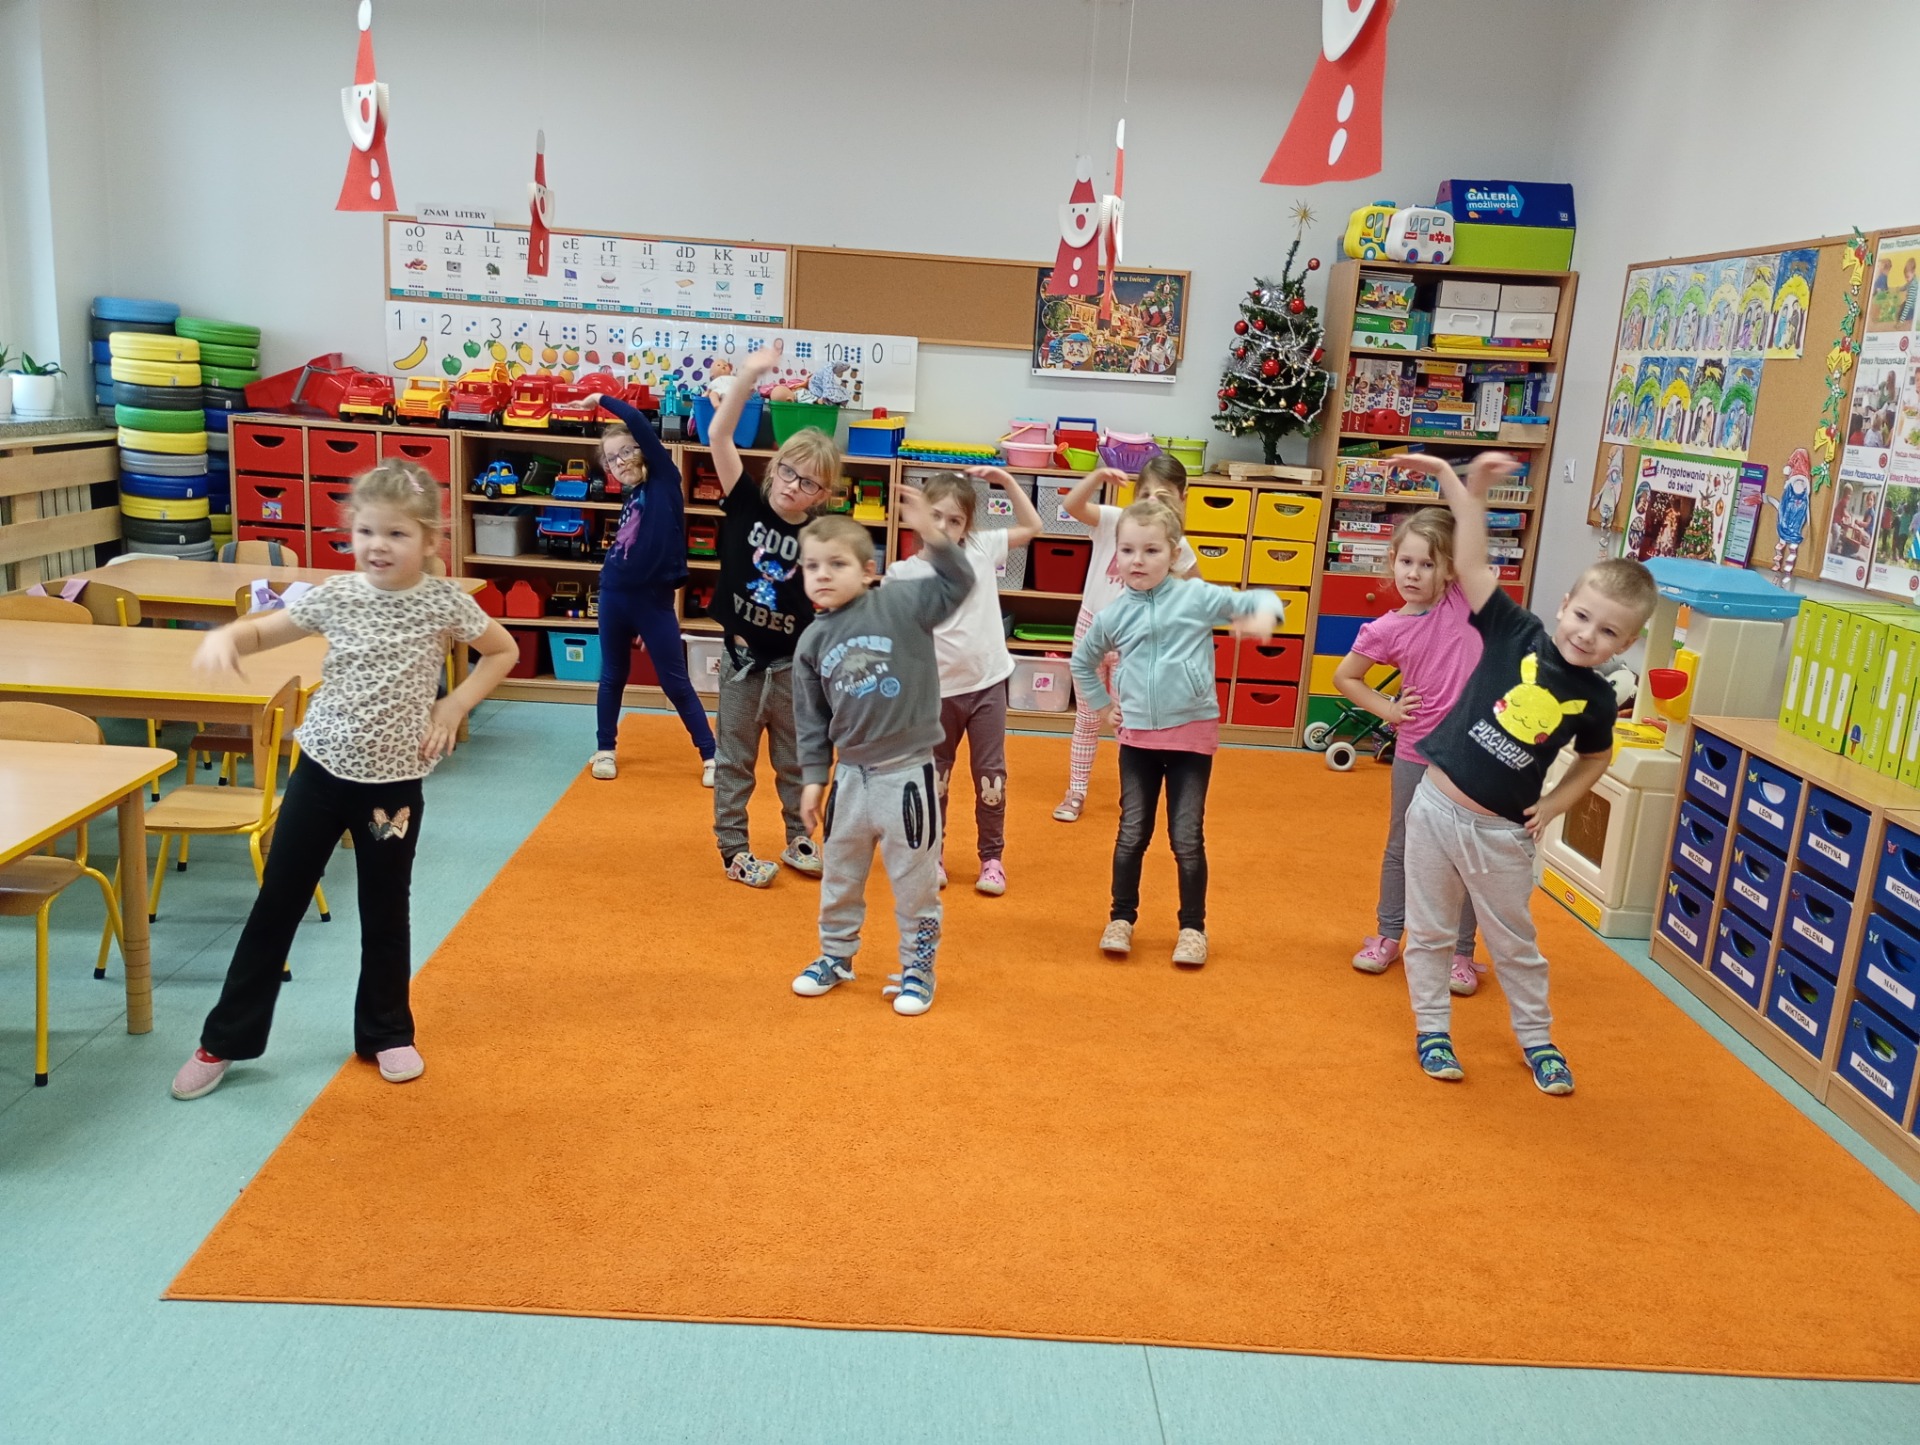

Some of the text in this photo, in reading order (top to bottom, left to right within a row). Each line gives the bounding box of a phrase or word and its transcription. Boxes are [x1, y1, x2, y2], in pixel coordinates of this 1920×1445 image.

[1467, 192, 1518, 201] GALERIA
[1468, 200, 1519, 209] możliwości
[423, 208, 487, 220] ZNAM LITERY
[394, 309, 401, 330] 1
[440, 313, 452, 335] 2
[490, 317, 502, 339] 3
[538, 320, 550, 342] 4
[585, 324, 598, 345] 5
[631, 326, 643, 348] 6
[678, 330, 690, 351] 7
[724, 333, 736, 355] 8
[824, 342, 843, 362] 10
[872, 342, 884, 364] 0
[1660, 464, 1706, 481] Przygotowania
[1667, 480, 1676, 490] do
[747, 521, 799, 560] GOO
[733, 592, 796, 635] VIBES
[1471, 718, 1534, 768] PIKACHU
[1701, 775, 1720, 791] SZYMON
[1758, 806, 1773, 821] LEON
[1687, 850, 1704, 866] MIŁOSZ
[1815, 839, 1842, 861] MARTYNA
[1740, 885, 1760, 903] KACPER
[1891, 881, 1920, 909] WERONIK
[1801, 924, 1824, 946] HELENA
[1730, 962, 1744, 978] KUBA
[1784, 1002, 1810, 1029] WIKTORIA
[1856, 1060, 1888, 1091] ADRIANNA
